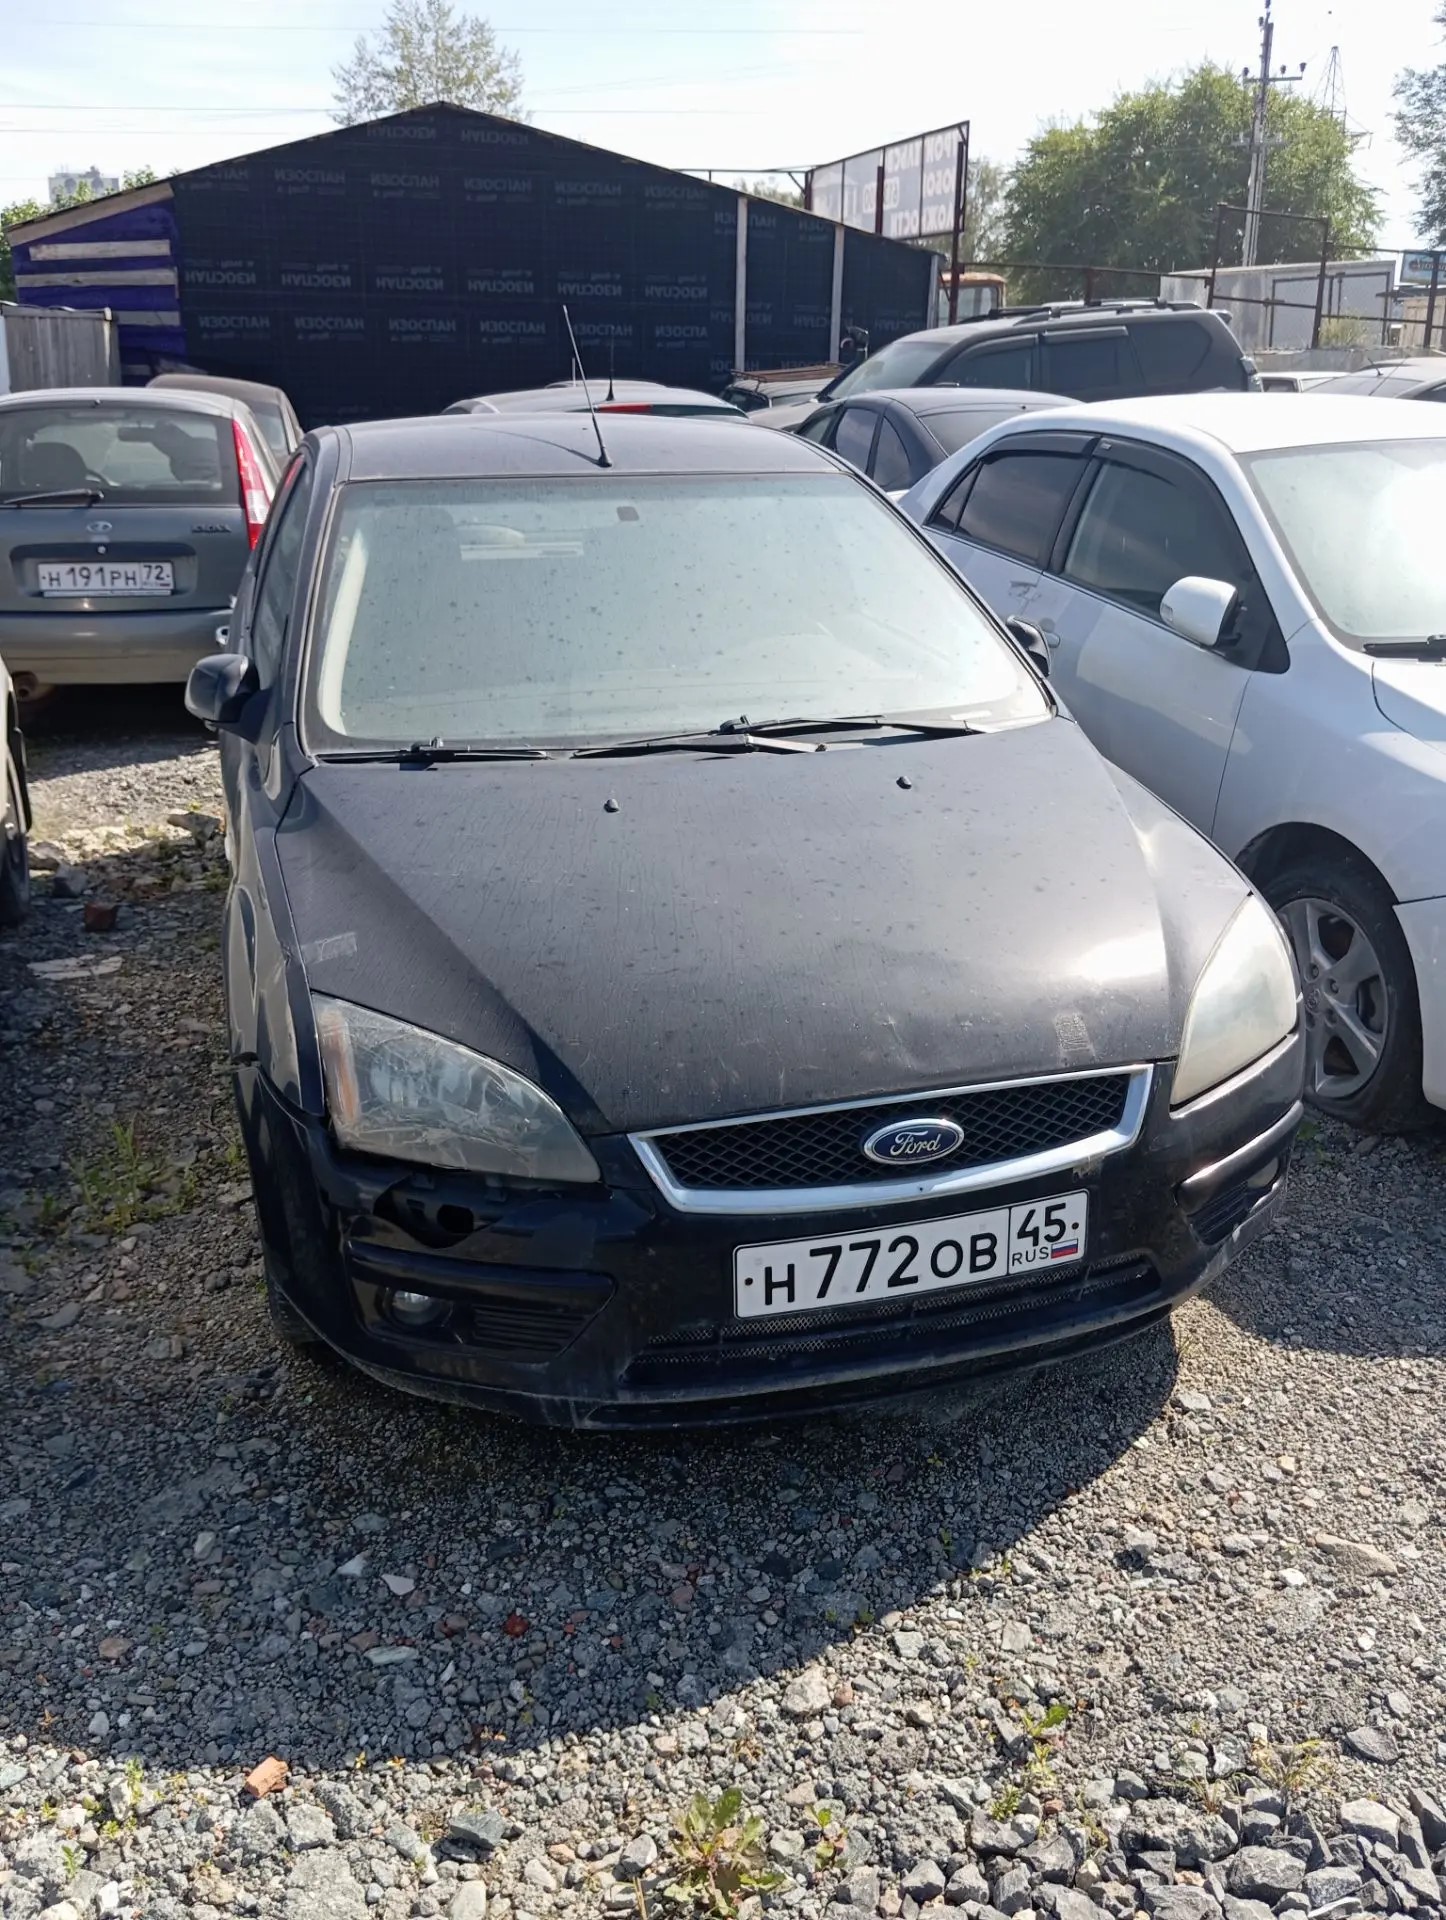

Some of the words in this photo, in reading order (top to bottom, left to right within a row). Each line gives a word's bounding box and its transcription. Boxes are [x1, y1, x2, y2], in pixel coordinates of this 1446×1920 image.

[274, 167, 346, 185] ИЗОСПАН
[370, 172, 440, 188] ИЗОСПАН
[464, 176, 532, 192] ИЗОСПАН
[184, 270, 256, 286] ИЗОСПАН
[281, 272, 351, 288] ИЗОСПАН
[376, 275, 444, 291] ИЗОСПАН
[467, 279, 534, 294] ИЗОСПАН
[557, 282, 622, 297] ИЗОСПАН
[644, 284, 708, 299] ИЗОСПАН
[198, 315, 270, 330] ИЗОСПАН
[294, 316, 364, 331] ИЗОСПАН
[388, 317, 457, 333] ИЗОСПАН
[479, 320, 546, 335] ИЗОСПАН
[142, 564, 165, 581] 72
[890, 1130, 942, 1157] Ford
[764, 1231, 999, 1306] Н772ОВ
[1016, 1202, 1067, 1248] 45
[1011, 1245, 1050, 1267] RUS
